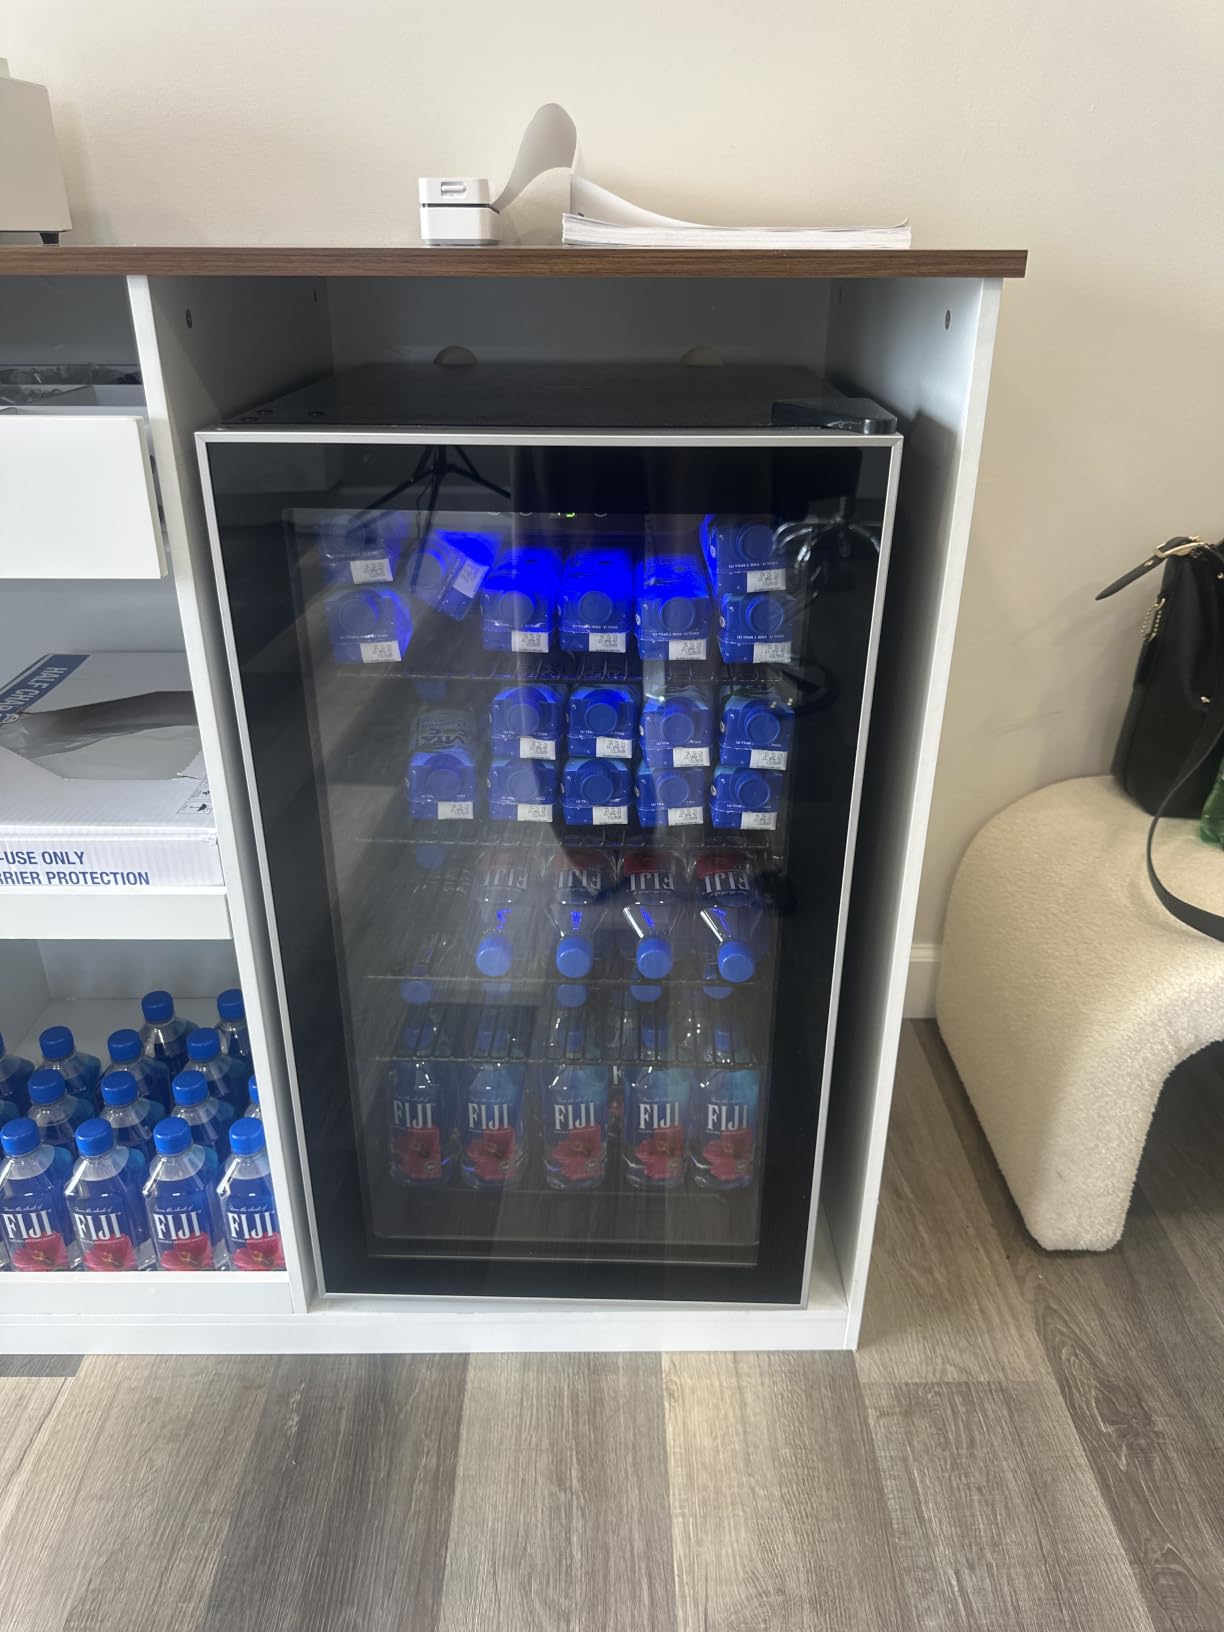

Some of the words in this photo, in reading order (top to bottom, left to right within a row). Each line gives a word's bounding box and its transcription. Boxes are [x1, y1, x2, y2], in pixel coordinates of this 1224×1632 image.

[27, 667, 68, 689] HALF
[42, 851, 84, 865] ONLY
[46, 871, 150, 886] PROTECTION
[630, 872, 675, 891] FIJI
[703, 871, 751, 894] FIJI
[393, 1099, 432, 1129] FIJI
[468, 1102, 509, 1130] FIJI
[553, 1103, 595, 1131] FIJI
[639, 1102, 680, 1131] FIJI
[707, 1103, 748, 1131] FIJI
[1, 1210, 53, 1239] FIJI
[73, 1212, 122, 1241] FIJI
[152, 1211, 201, 1240] FIJI
[226, 1211, 273, 1240] FIJI
